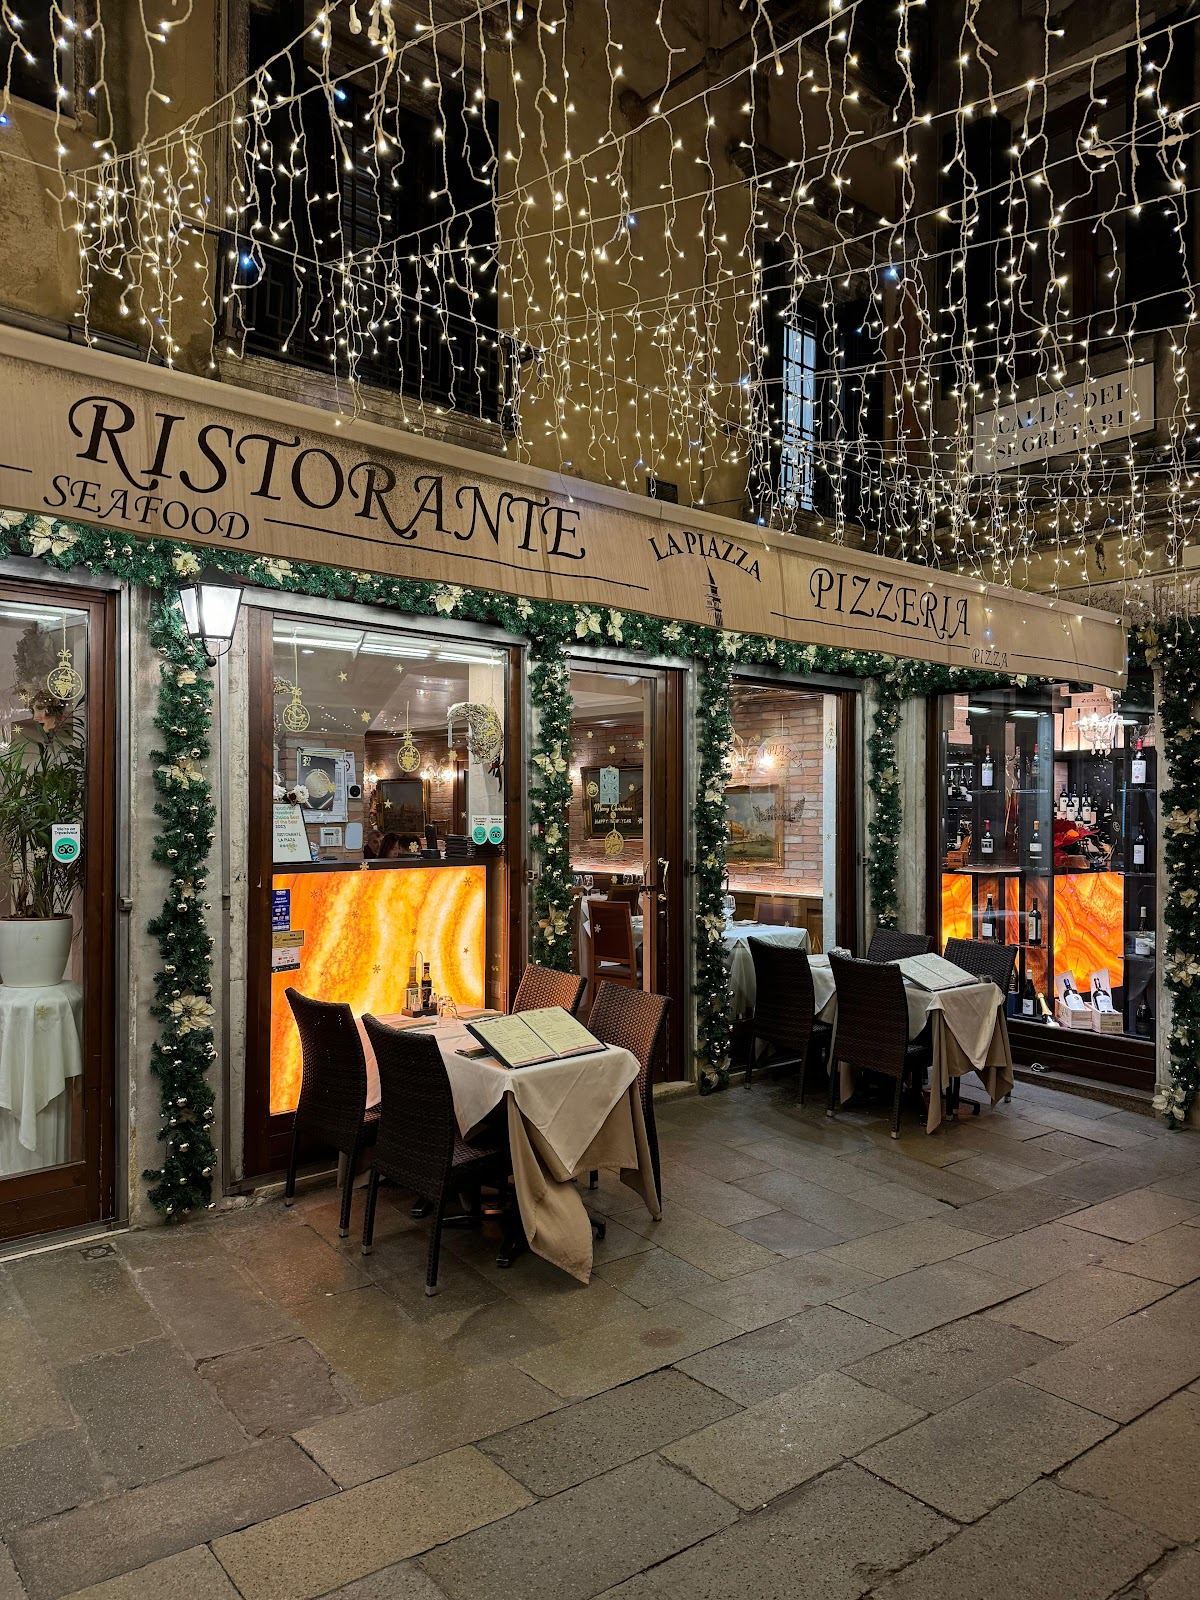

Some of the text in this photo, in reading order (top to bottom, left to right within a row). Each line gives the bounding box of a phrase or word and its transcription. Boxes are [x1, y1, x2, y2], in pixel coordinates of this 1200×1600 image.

[998, 383, 1123, 433] CALLE DEI
[997, 410, 1123, 460] SEGRETARI
[68, 396, 586, 560] RISTORANTE
[43, 475, 250, 540] SEAFOOD
[648, 531, 762, 582] LA PIAZZA
[809, 567, 971, 639] PIZZERIA
[972, 648, 1009, 669] PIZZA
